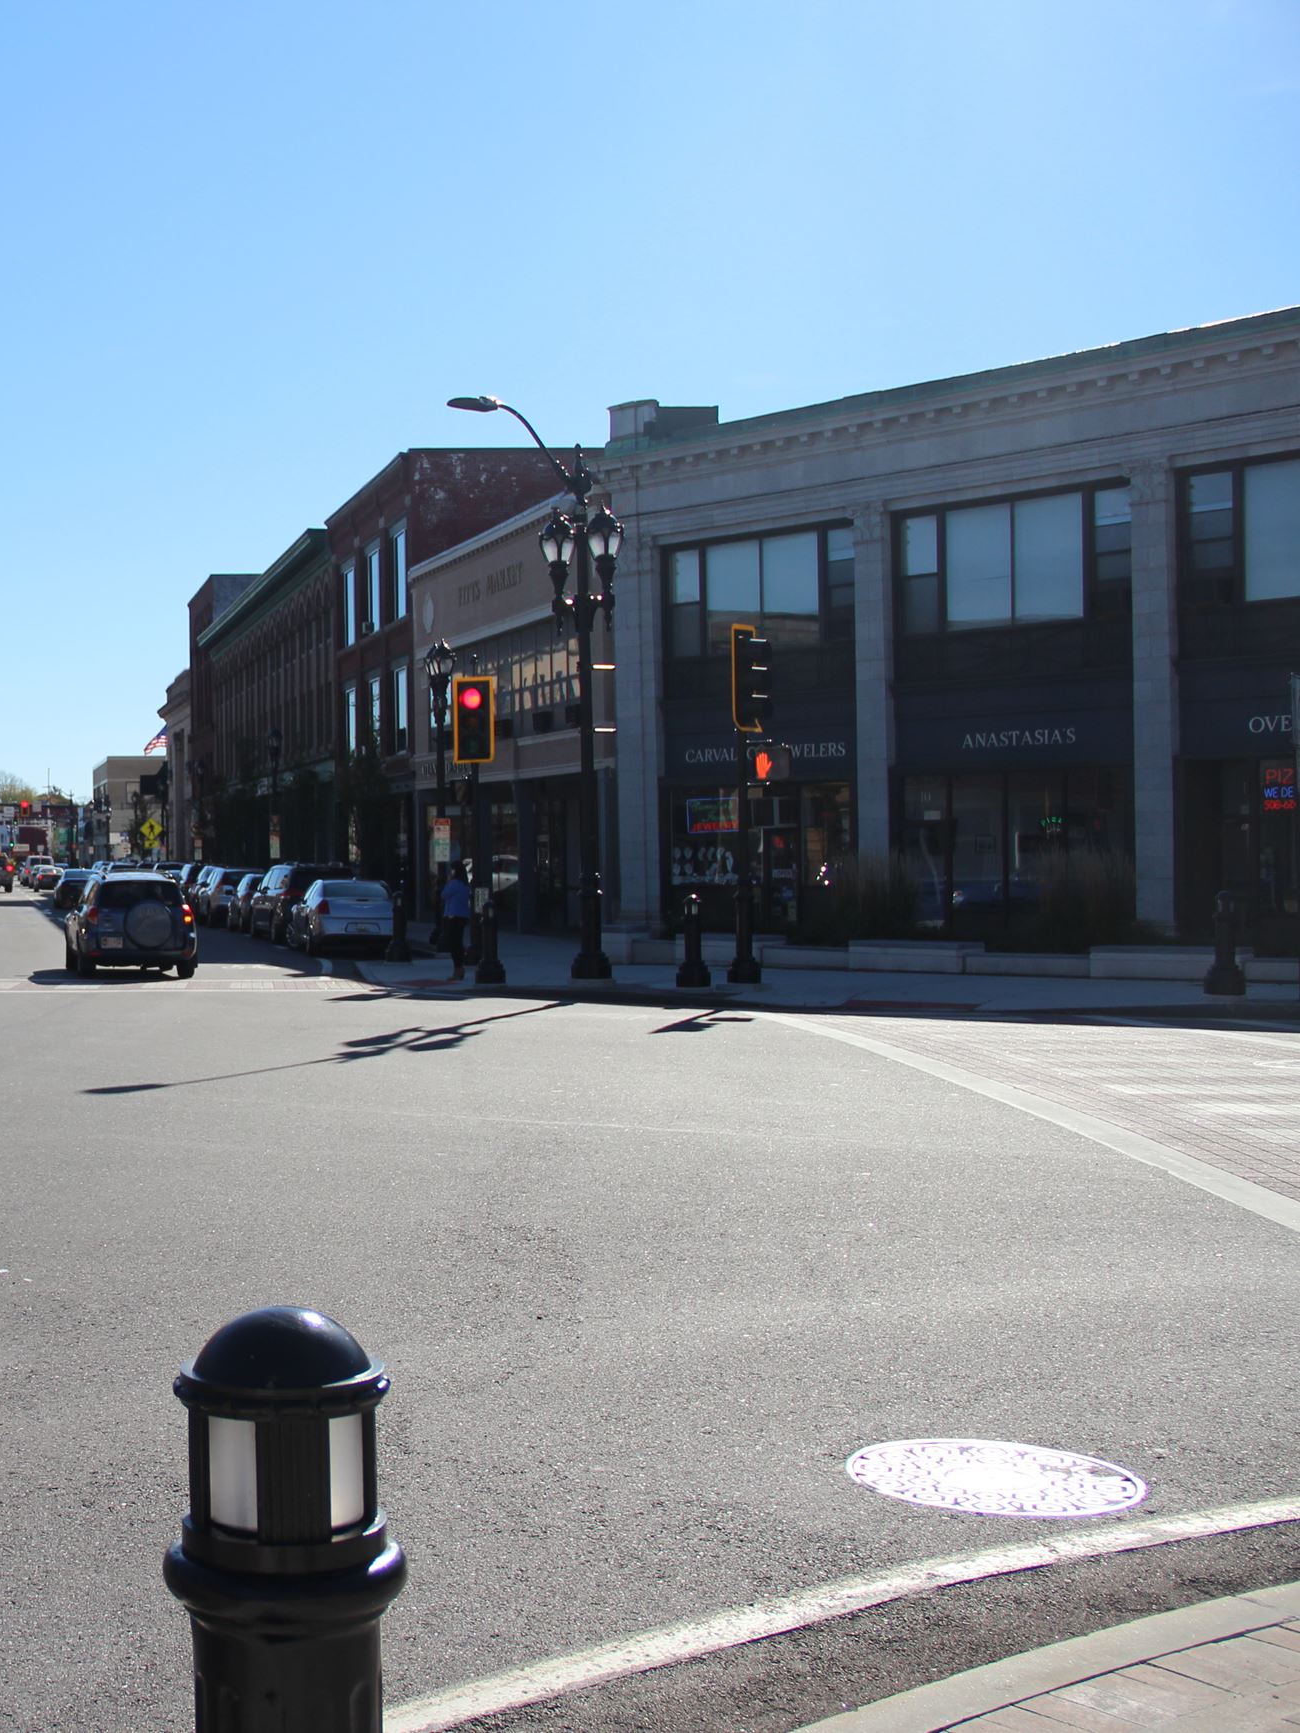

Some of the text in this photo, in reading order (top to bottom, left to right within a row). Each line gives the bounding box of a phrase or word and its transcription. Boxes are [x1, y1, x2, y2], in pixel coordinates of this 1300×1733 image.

[1249, 714, 1292, 733] OVE
[962, 727, 1076, 749] ANASTASIA'S
[1265, 768, 1293, 784] PIZ
[1263, 785, 1294, 798] WE DE
